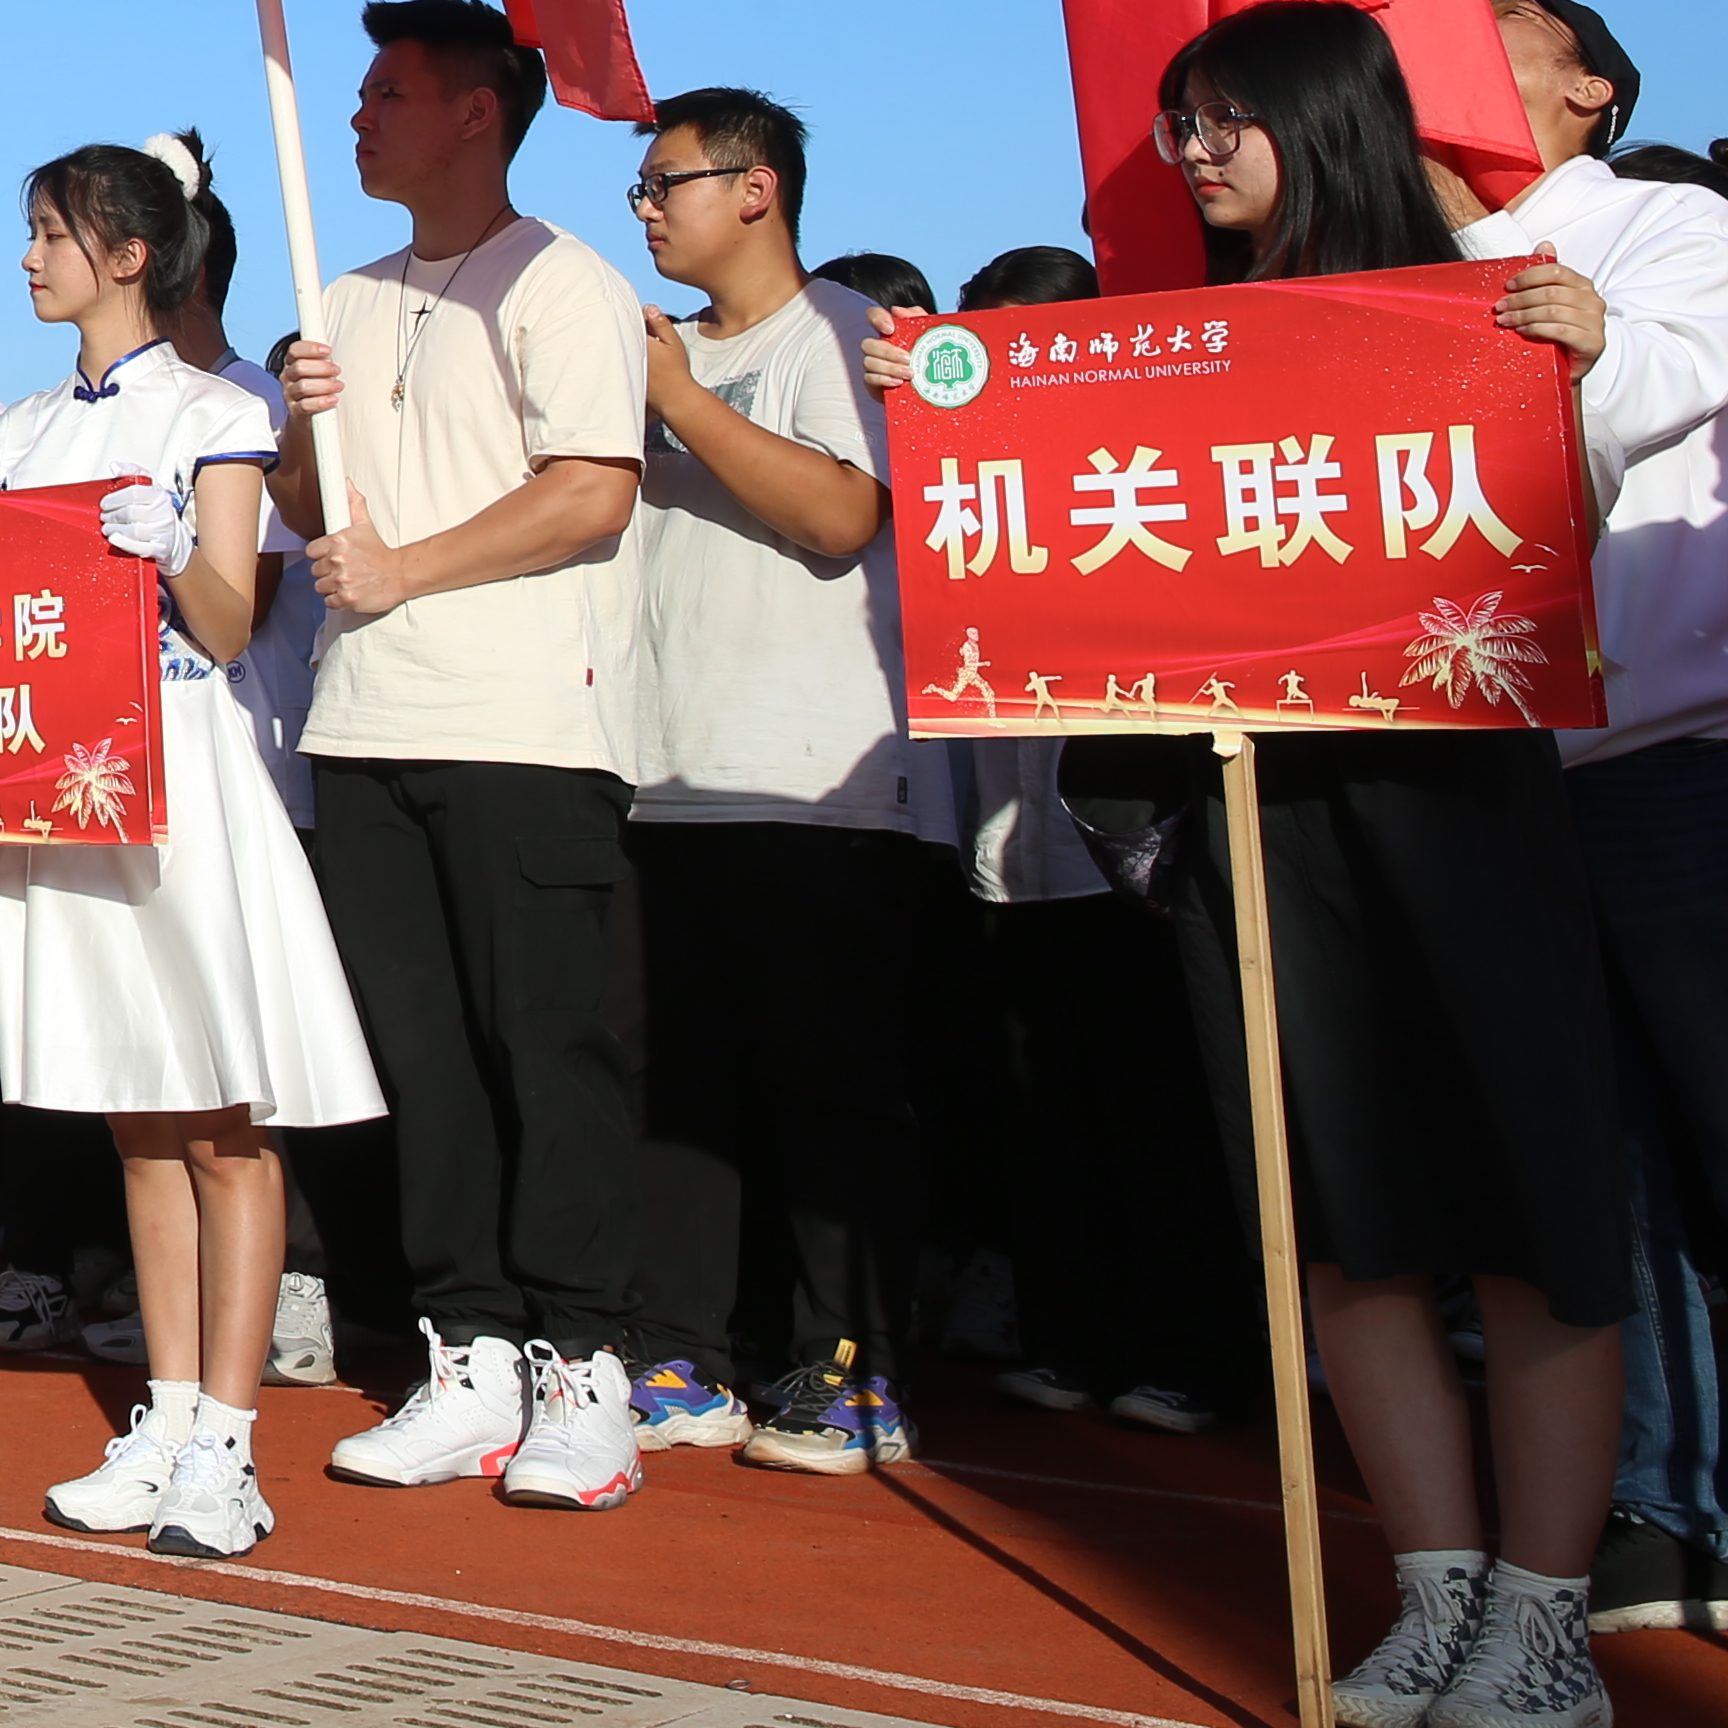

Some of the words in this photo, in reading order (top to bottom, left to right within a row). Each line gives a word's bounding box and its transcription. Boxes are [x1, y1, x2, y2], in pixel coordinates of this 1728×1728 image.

[1007, 319, 1230, 368] 海南师范大学
[1010, 371, 1070, 389] HAINAN
[1073, 366, 1142, 384] NORMAL
[1145, 359, 1232, 381] UNIVERSITY
[922, 424, 1525, 580] 机关联队
